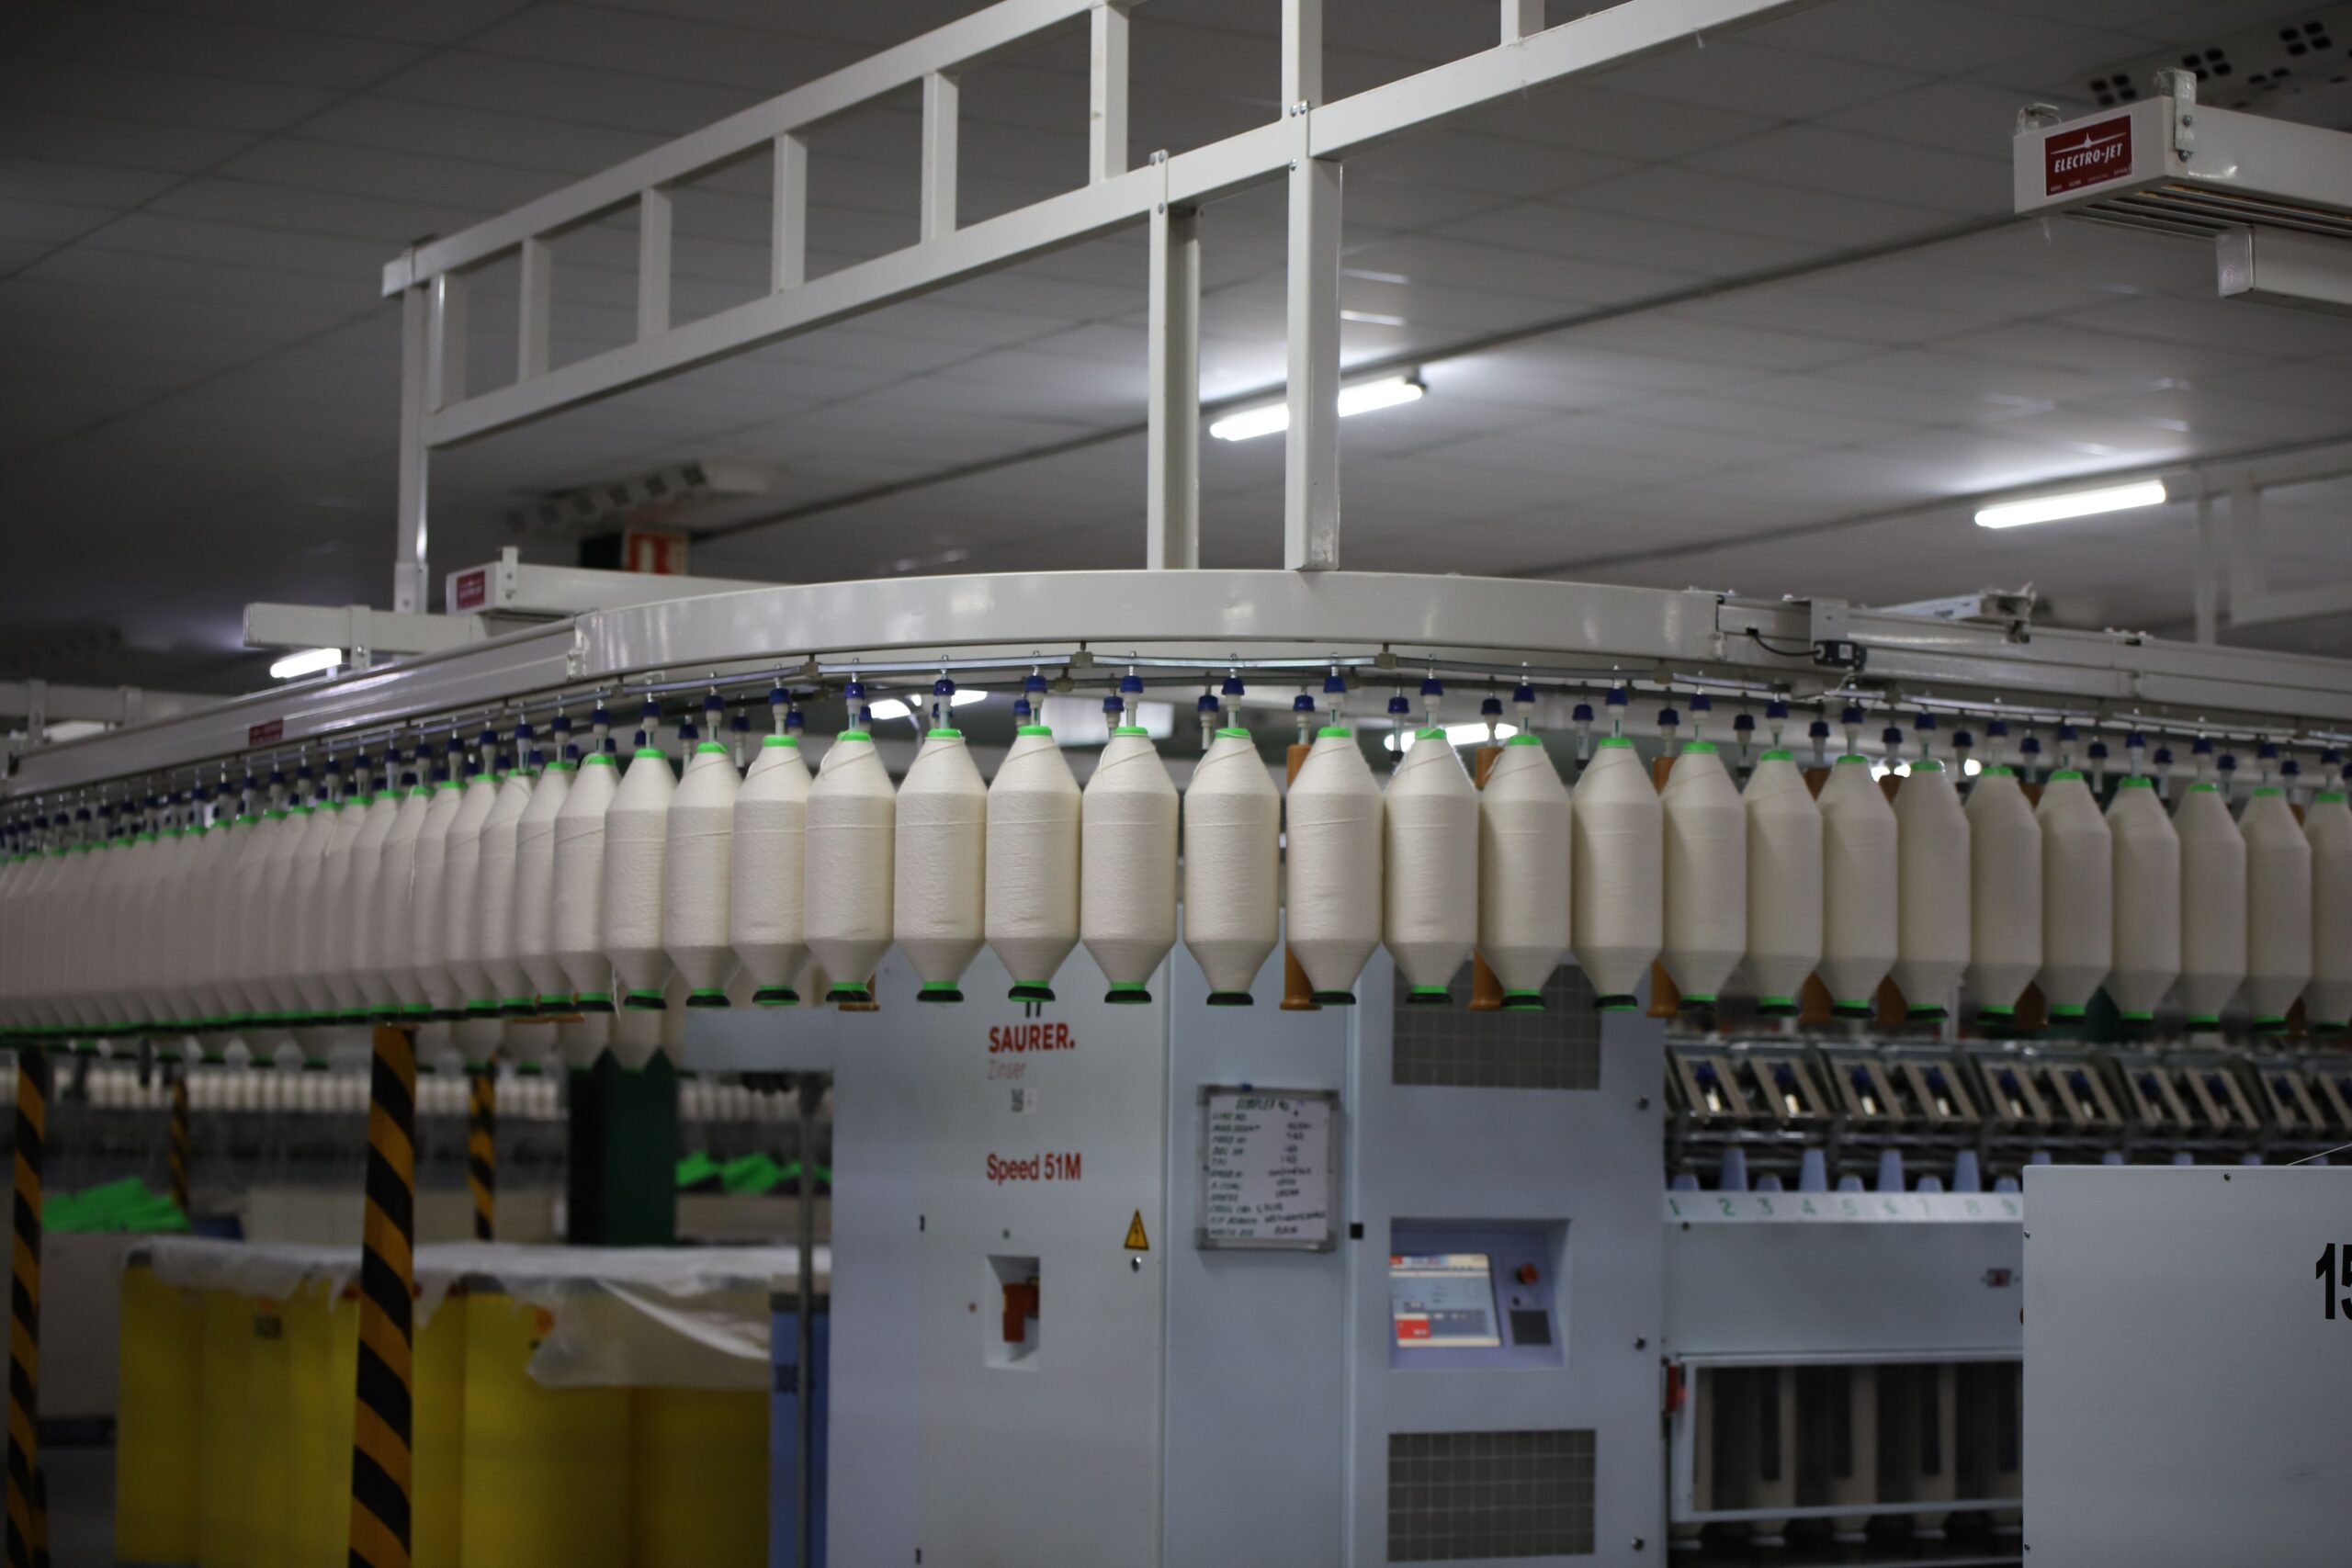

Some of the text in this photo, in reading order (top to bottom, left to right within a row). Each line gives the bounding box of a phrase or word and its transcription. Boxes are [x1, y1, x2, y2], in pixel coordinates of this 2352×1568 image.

[2054, 142, 2123, 174] ELECTRO-JET
[987, 1152, 1082, 1186] Speed 51M
[1668, 1197, 1681, 1216] 1
[1717, 1197, 1736, 1216] 2
[1757, 1197, 1774, 1216] 3
[1801, 1199, 1817, 1215] 4
[1841, 1197, 1860, 1216] 5
